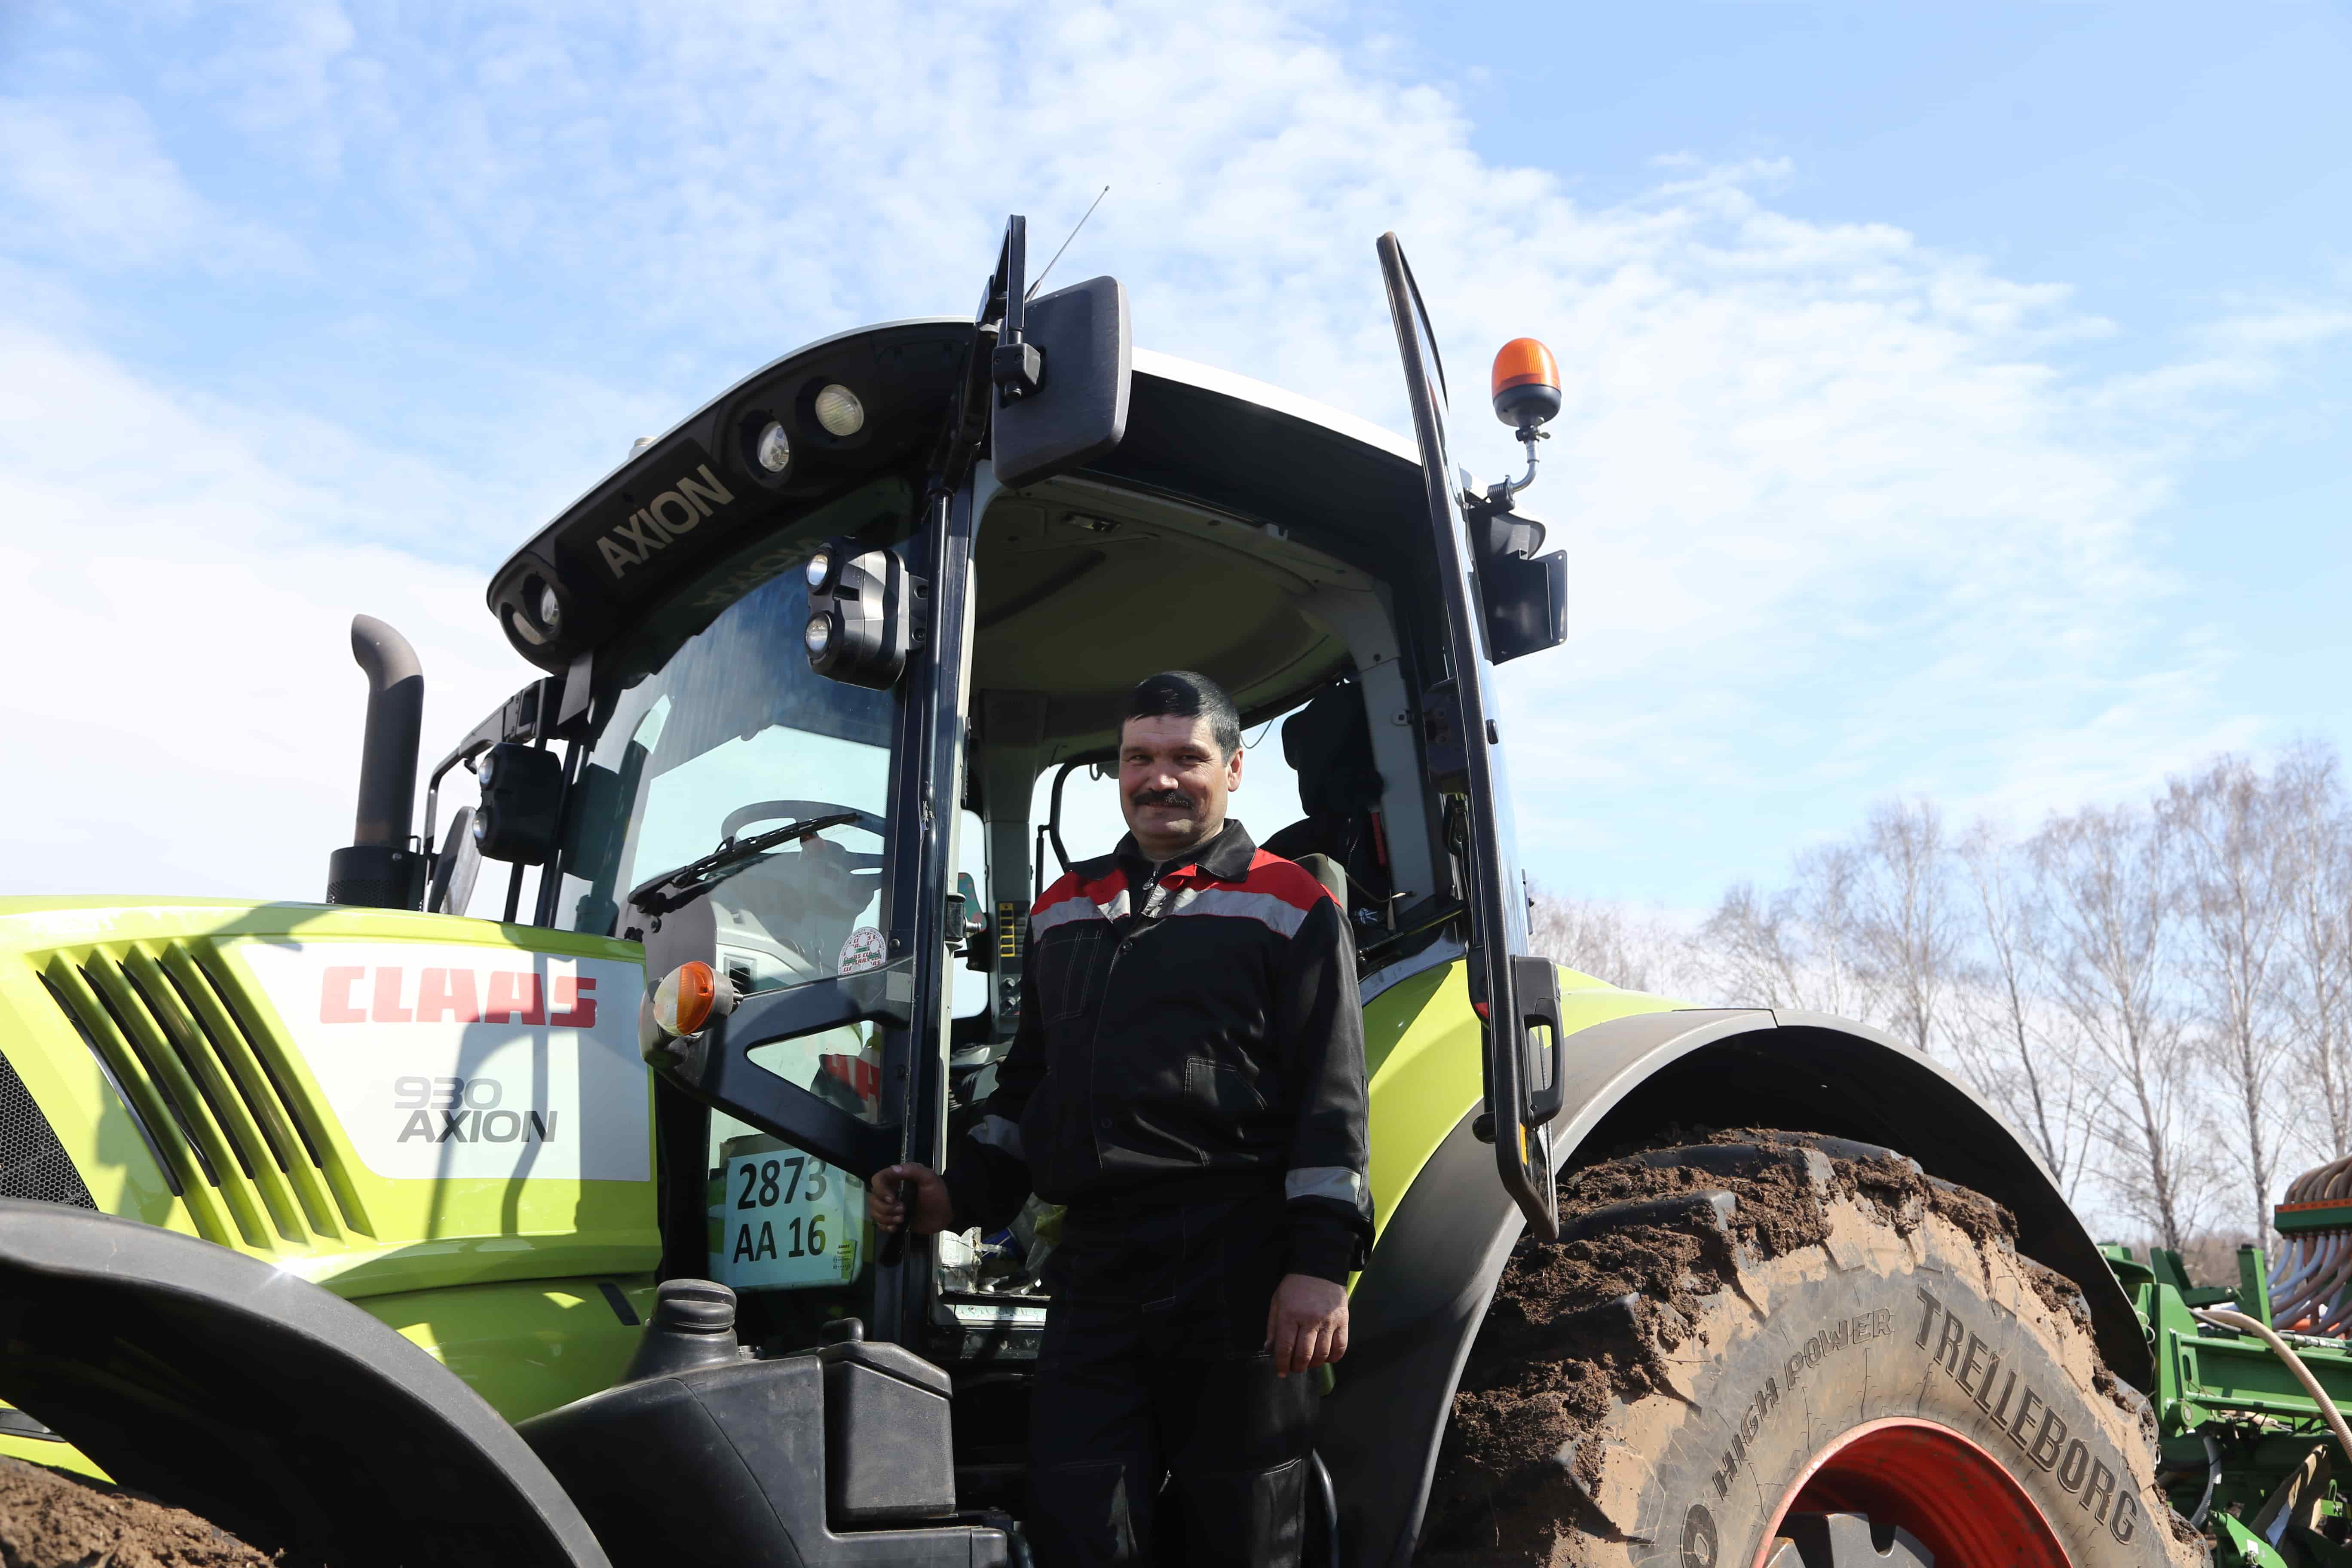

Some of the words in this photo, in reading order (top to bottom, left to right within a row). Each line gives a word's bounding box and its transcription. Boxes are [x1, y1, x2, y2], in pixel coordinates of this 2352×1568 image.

[597, 464, 735, 579] AXION
[319, 966, 597, 1028] CLAAS
[394, 1076, 502, 1109] 930
[397, 1110, 557, 1143] AXION
[738, 1155, 827, 1210] 2873
[789, 1215, 826, 1257] 16
[1713, 1377, 1779, 1501] HIGH
[1785, 1308, 1892, 1390] POWER
[1915, 1286, 2138, 1545] TRELLEBORG
